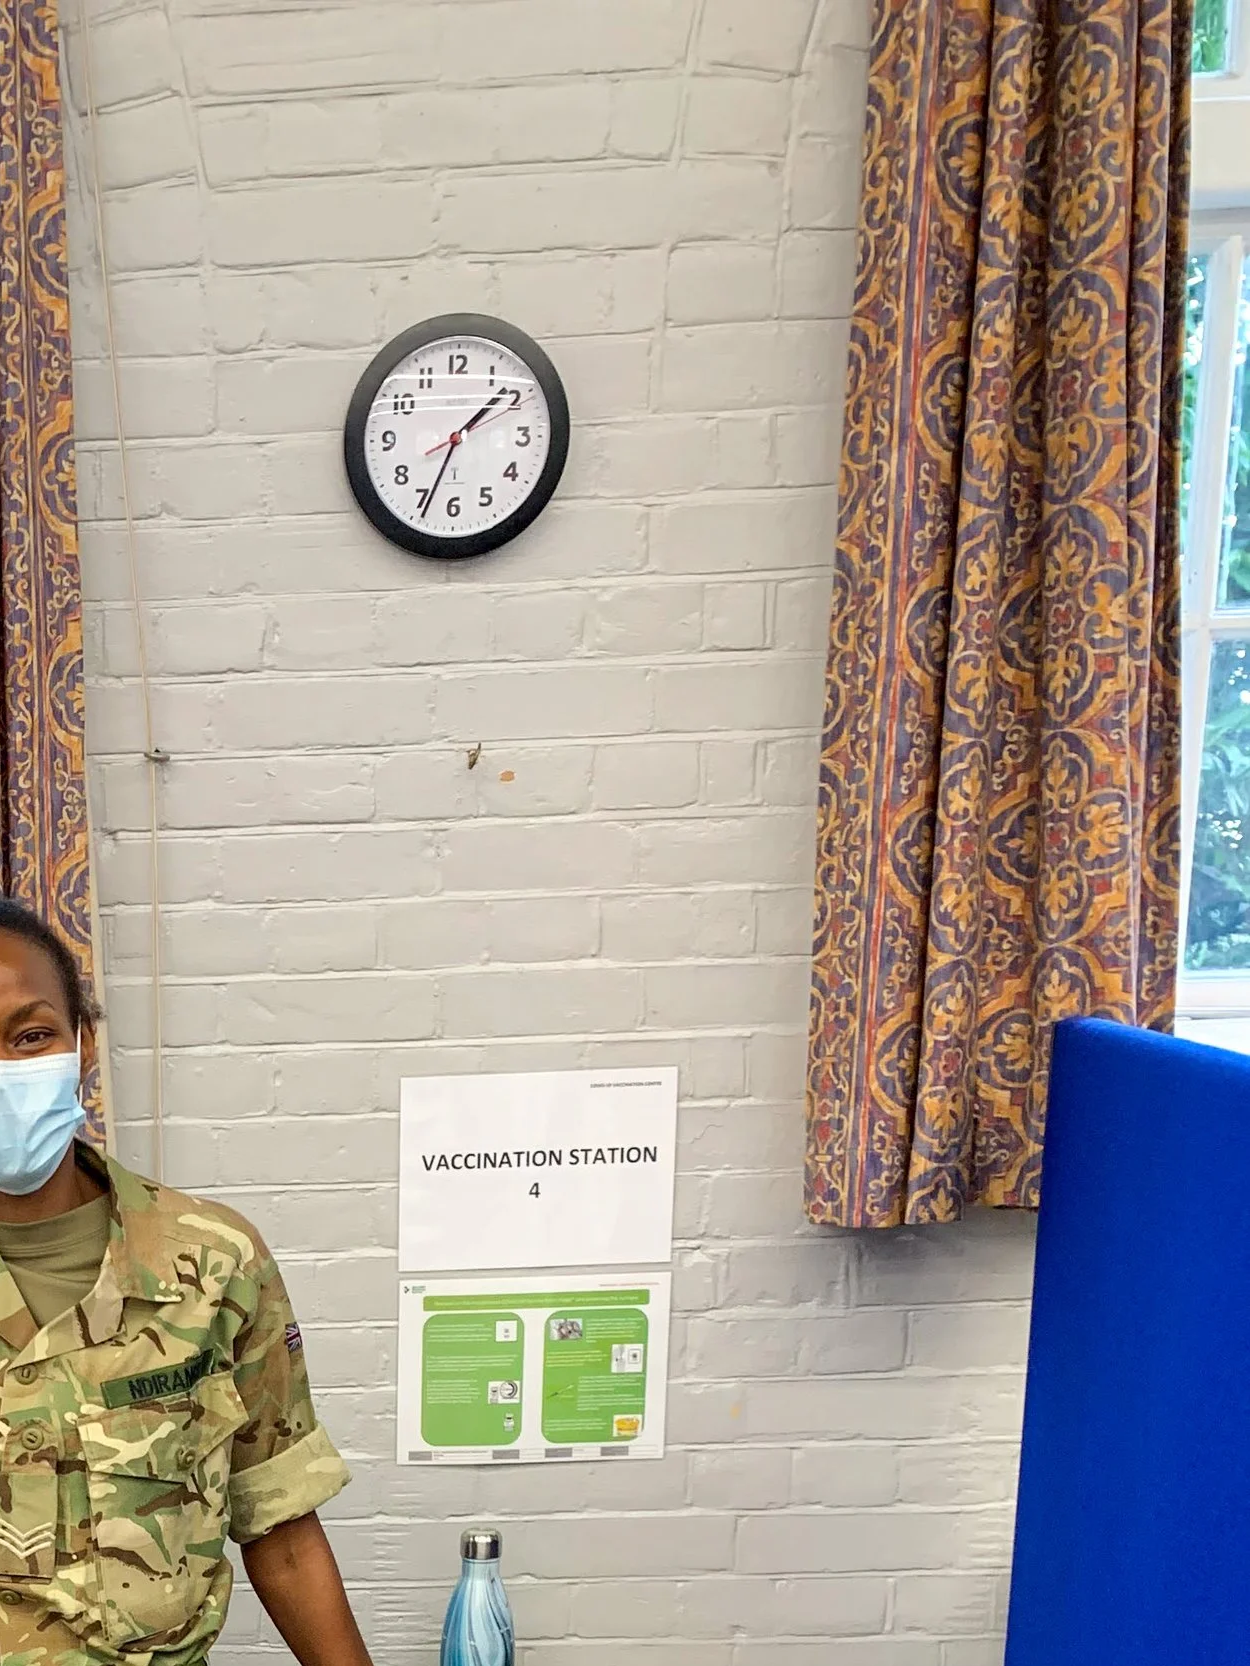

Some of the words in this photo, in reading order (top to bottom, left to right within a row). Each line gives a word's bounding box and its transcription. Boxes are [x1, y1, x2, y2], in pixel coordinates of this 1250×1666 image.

[448, 355, 468, 375] 12
[419, 367, 433, 389] 11
[489, 365, 495, 387] 1
[393, 393, 415, 415] 10
[507, 389, 521, 411] 2
[382, 430, 397, 451] 9
[515, 426, 531, 447] 3
[394, 464, 409, 485] 8
[503, 461, 519, 482] 4
[416, 488, 429, 509] 7
[446, 496, 460, 518] 6
[478, 487, 493, 507] 5
[422, 1149, 563, 1172] VACCINATION
[568, 1146, 658, 1166] STATION
[528, 1182, 541, 1199] 4
